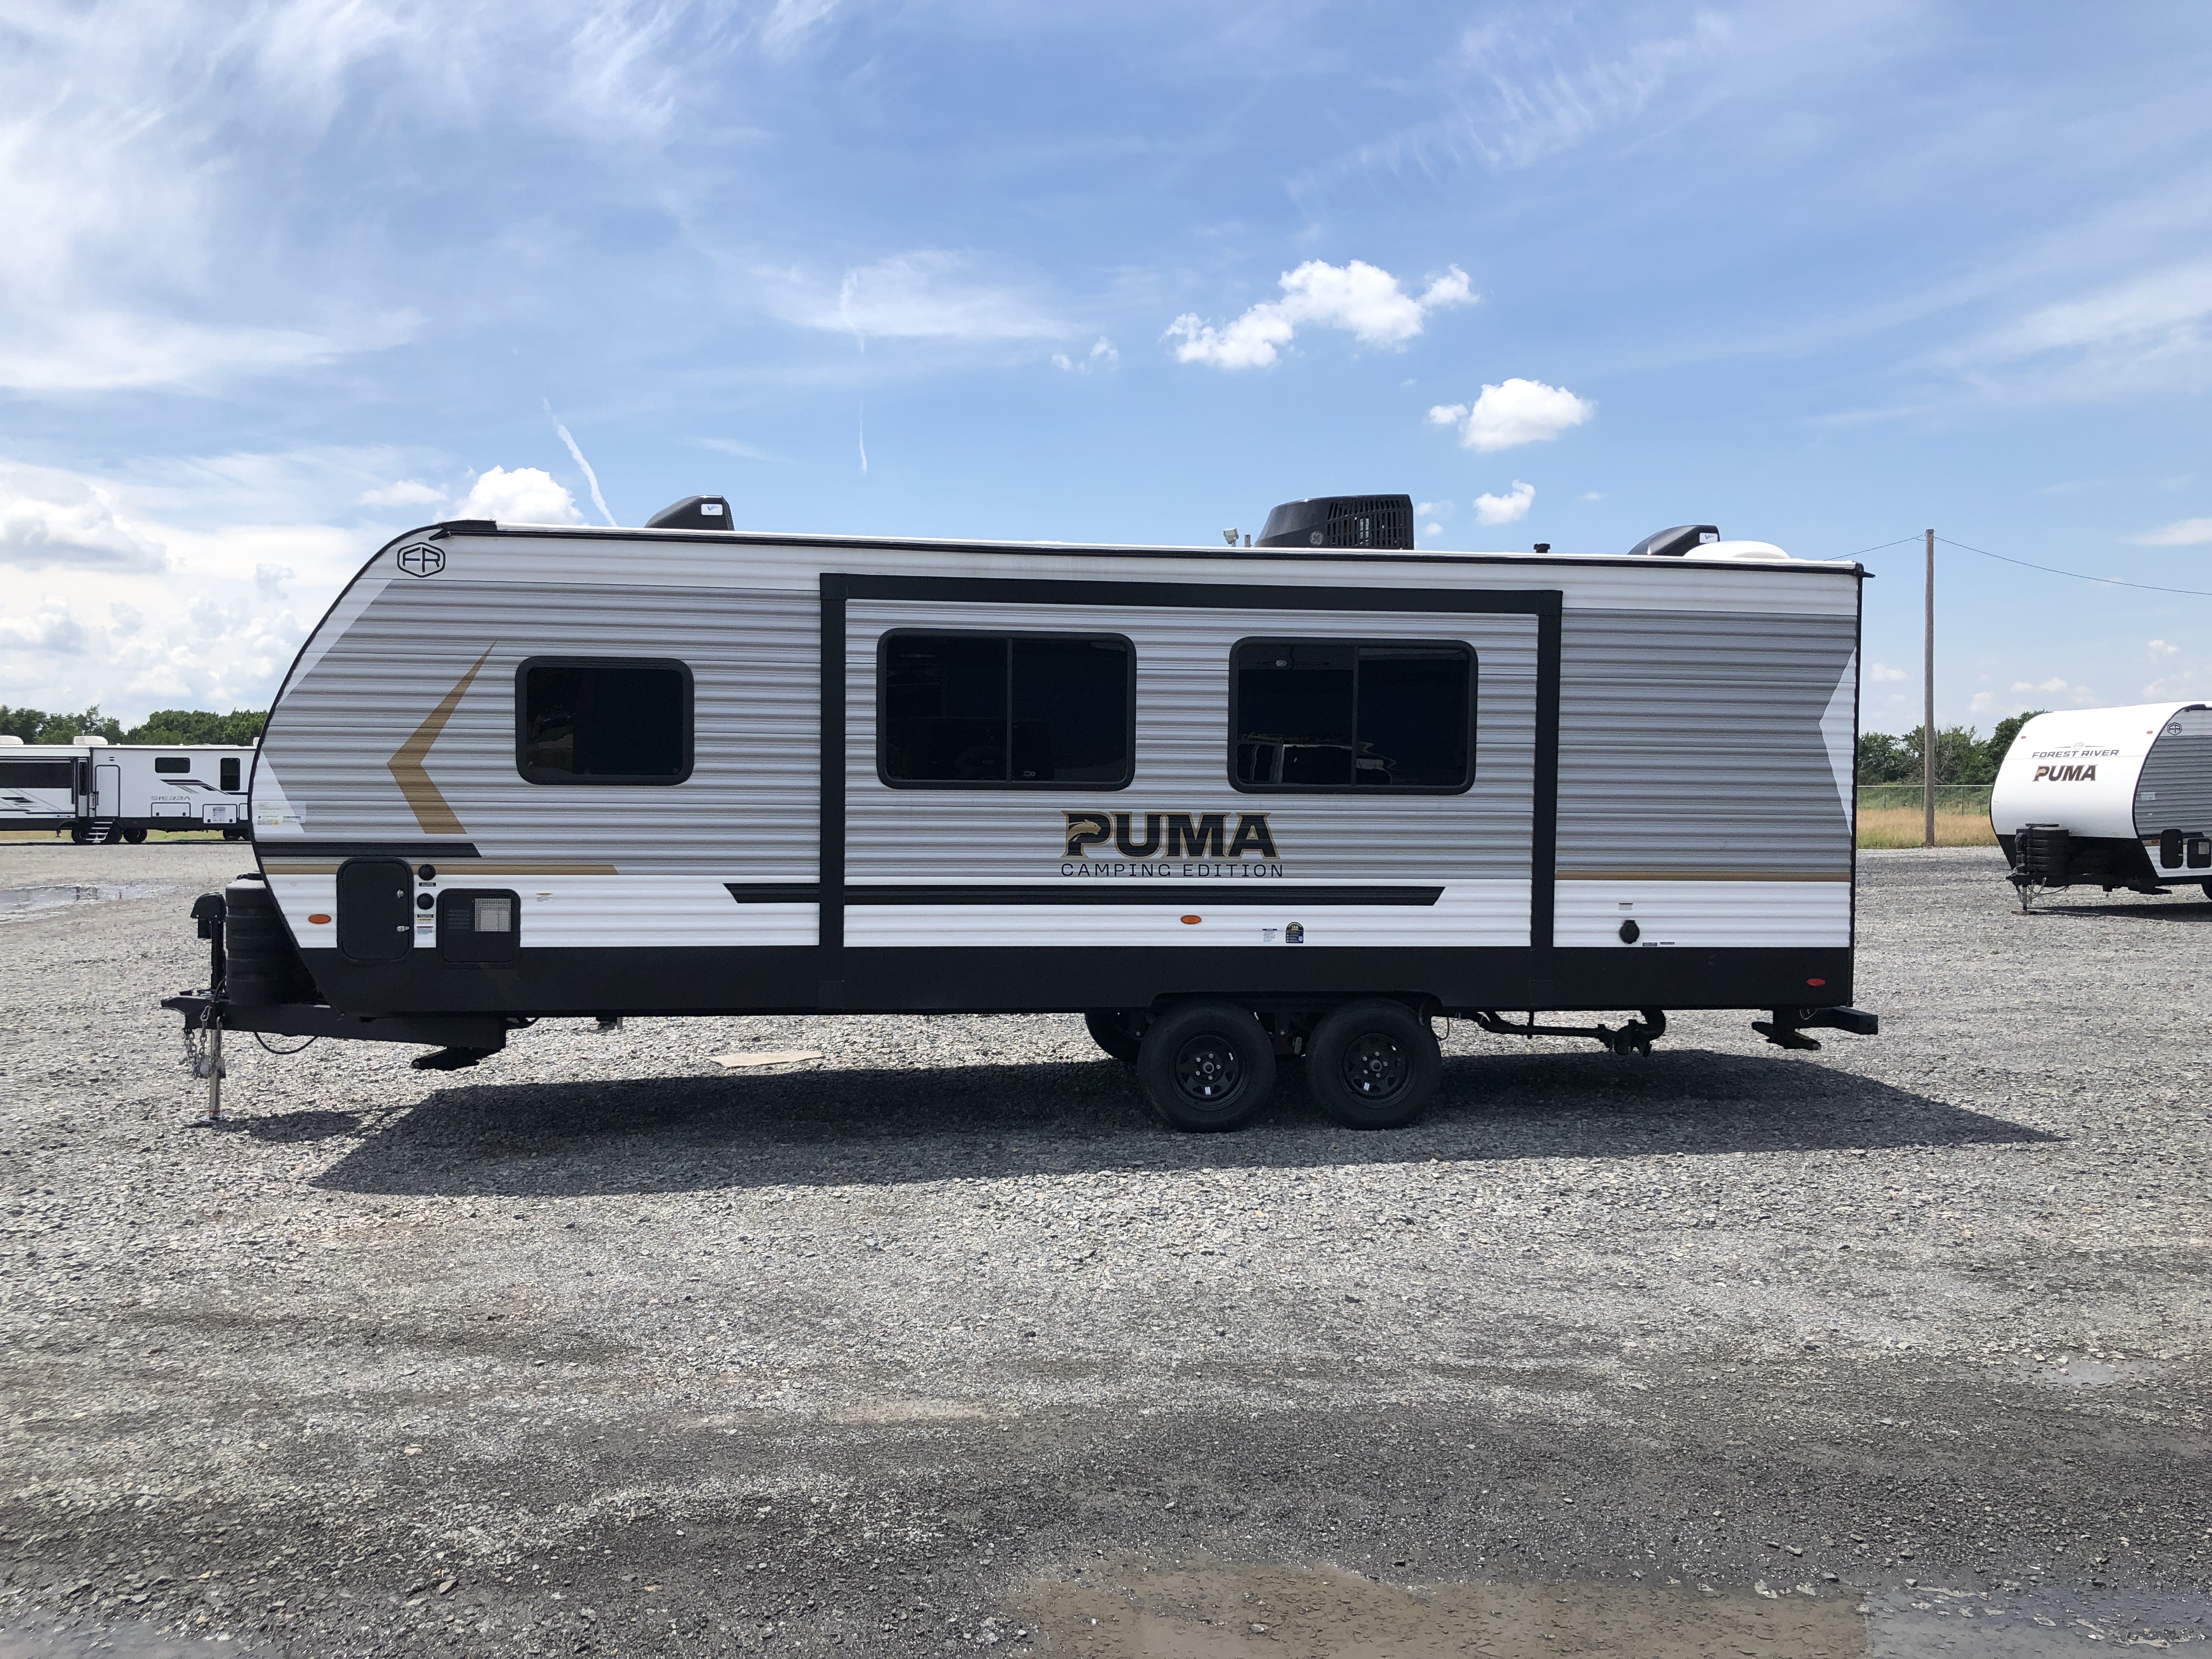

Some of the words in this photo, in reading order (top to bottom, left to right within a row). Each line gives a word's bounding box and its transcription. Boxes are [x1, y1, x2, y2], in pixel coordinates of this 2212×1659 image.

[403, 547, 440, 572] FR
[2032, 764, 2098, 782] PUMA
[1060, 810, 1280, 859] PUMA
[1061, 863, 1171, 877] CAMPING
[1183, 864, 1283, 877] EDITION
